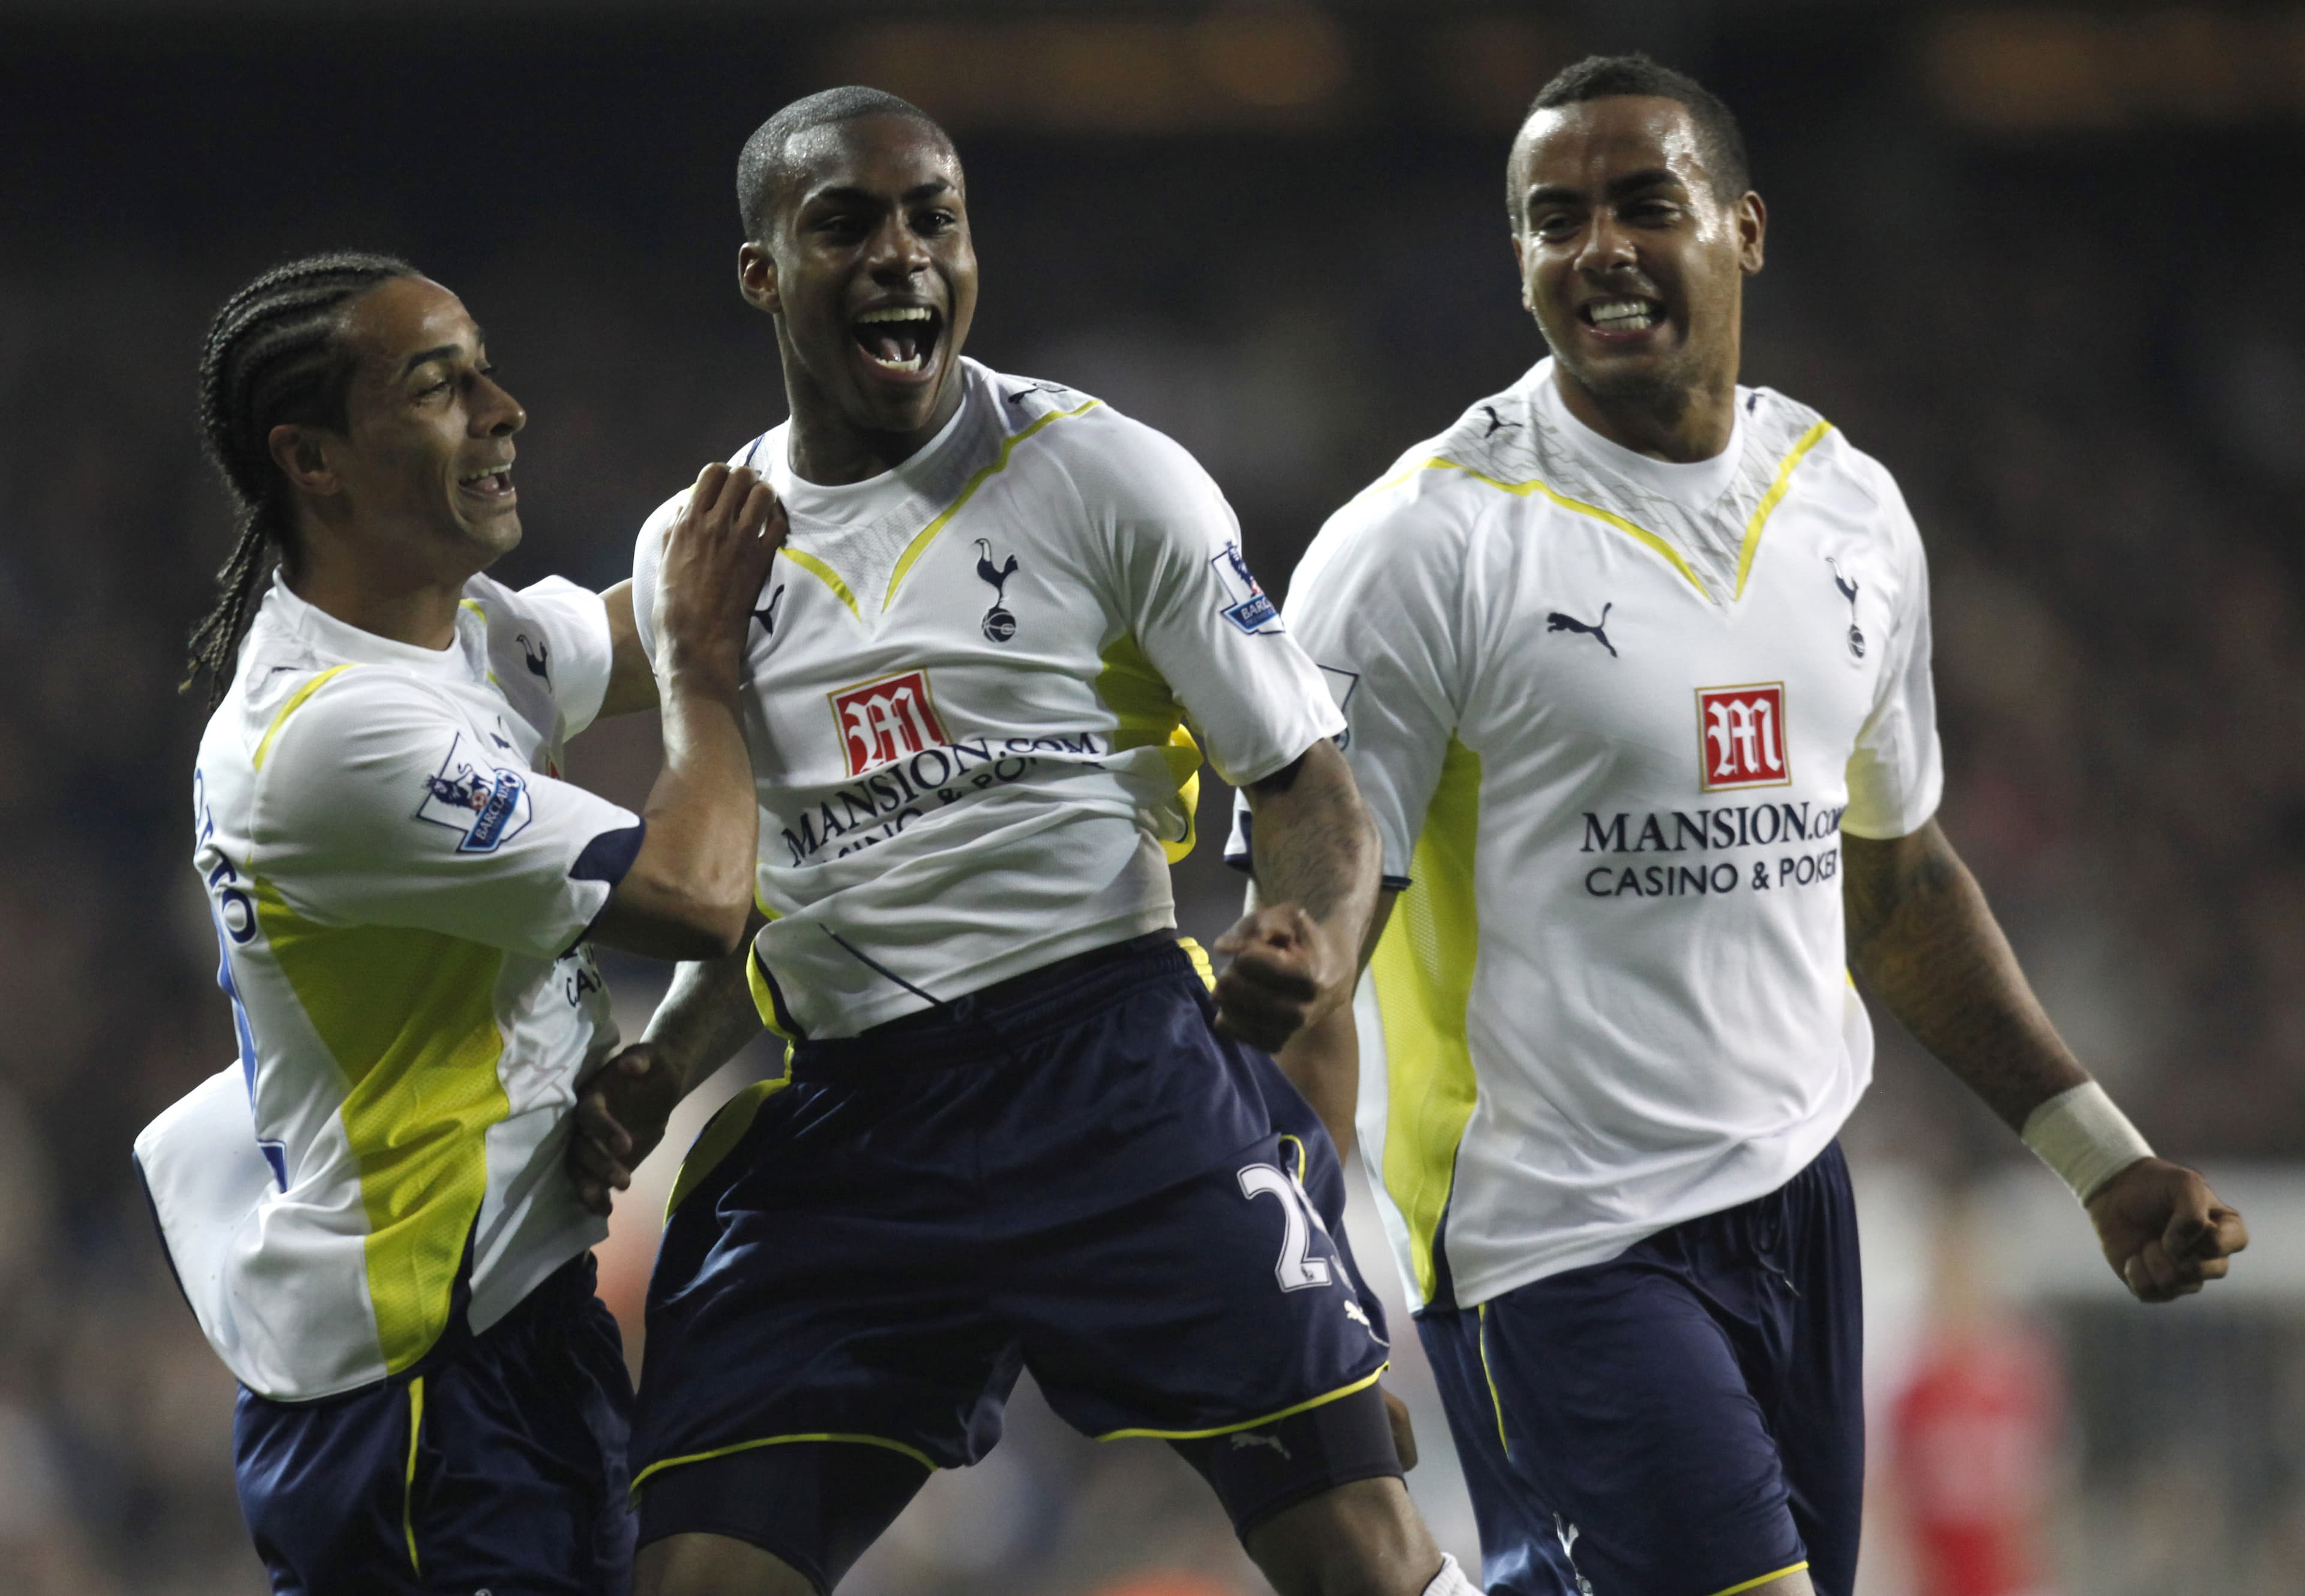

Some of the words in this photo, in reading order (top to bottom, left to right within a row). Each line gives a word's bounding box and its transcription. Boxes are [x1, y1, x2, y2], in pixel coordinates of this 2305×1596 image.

[781, 732, 1100, 868] MANSION.COM
[1585, 863, 1738, 897] CASINO
[1752, 861, 1770, 891] &
